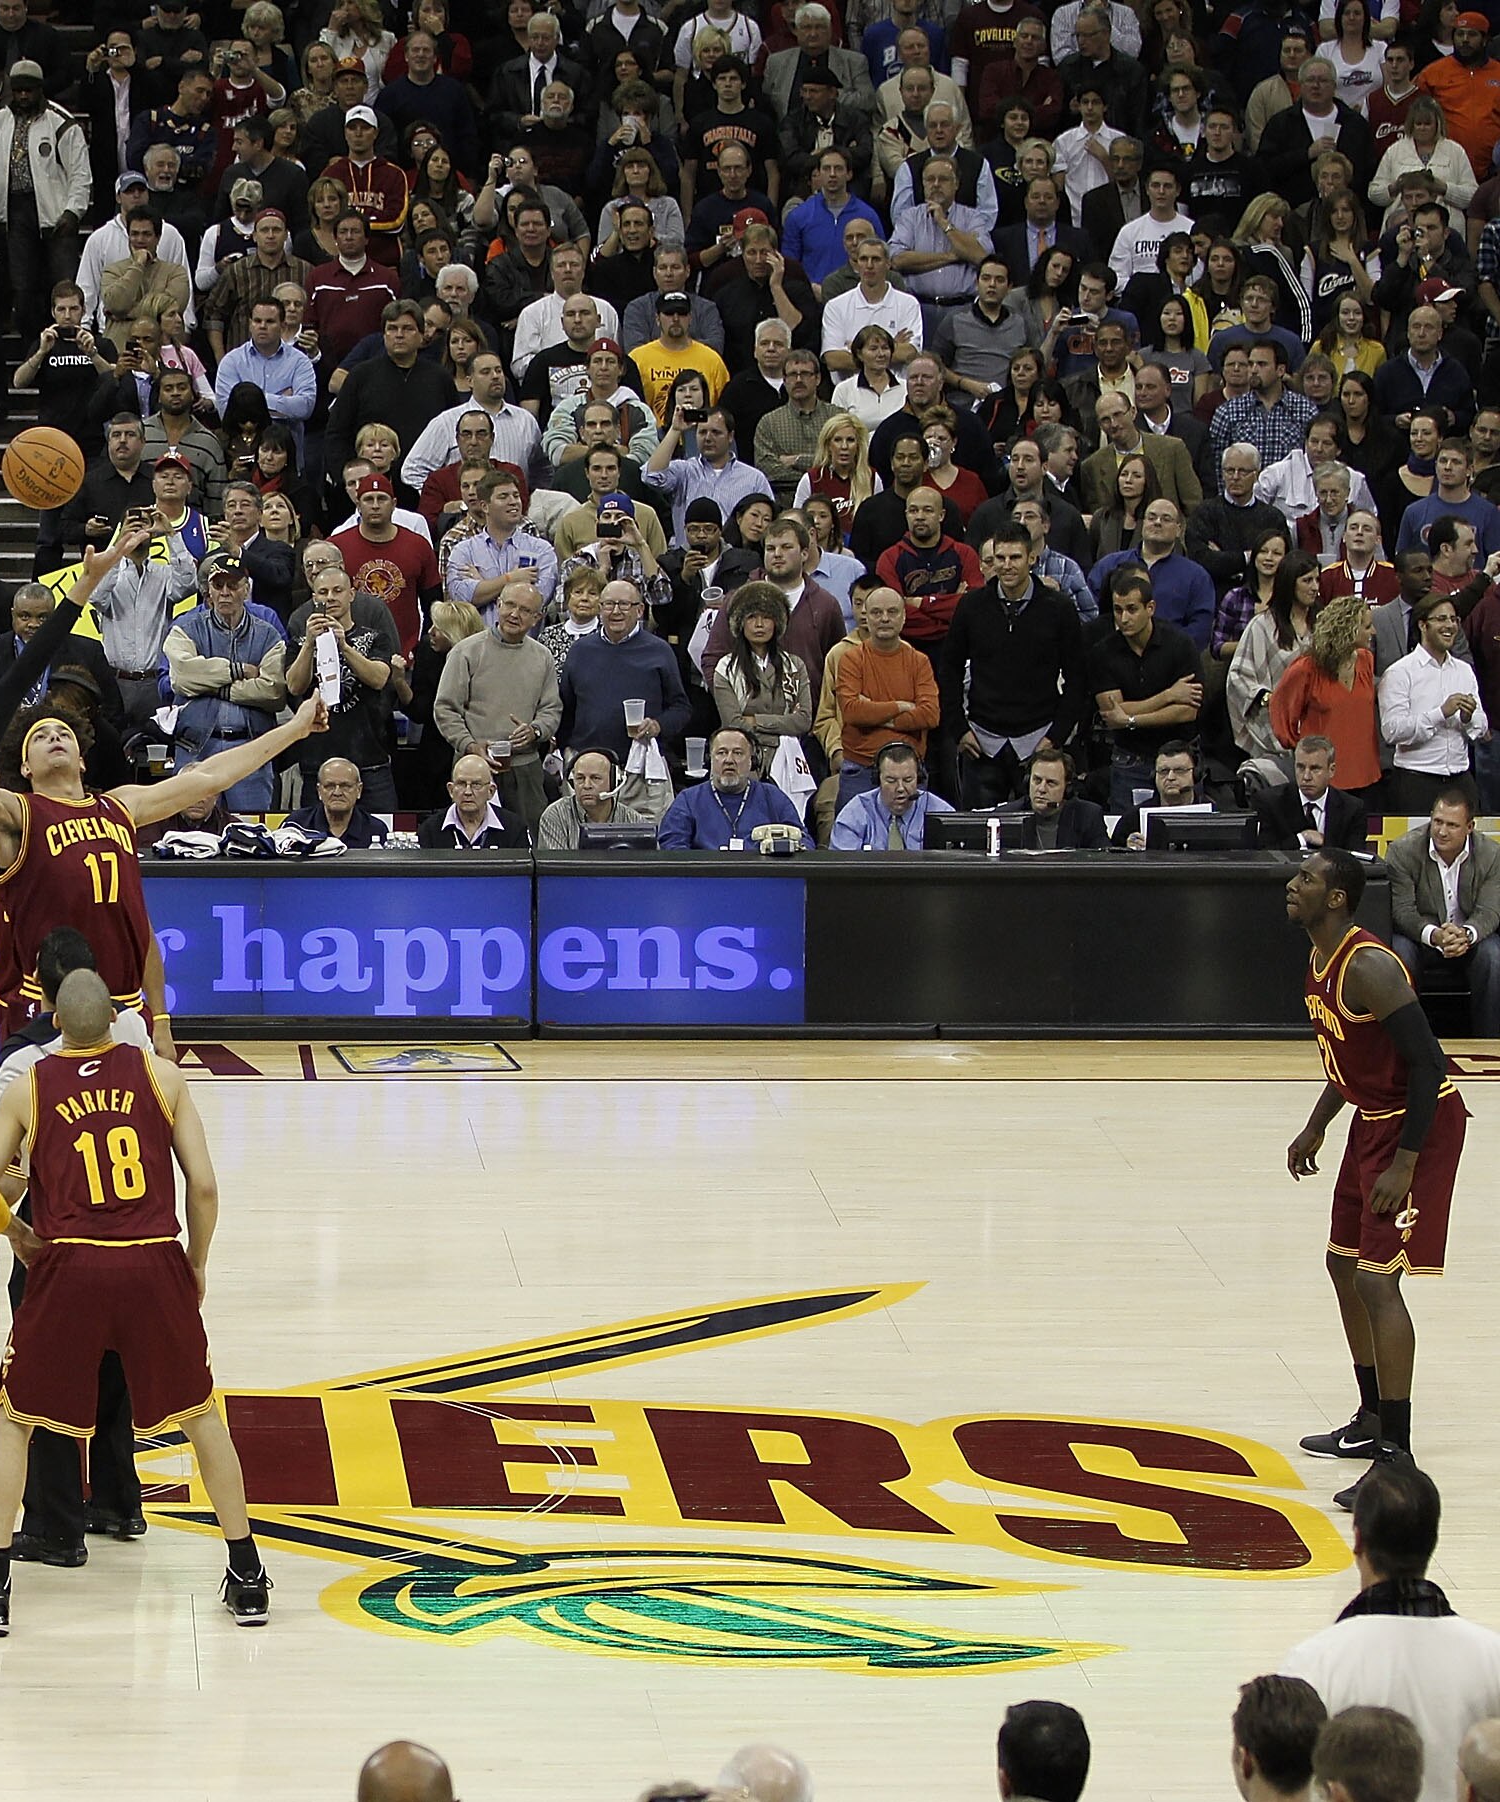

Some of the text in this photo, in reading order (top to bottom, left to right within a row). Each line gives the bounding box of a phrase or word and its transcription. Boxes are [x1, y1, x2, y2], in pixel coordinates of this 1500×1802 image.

[974, 28, 1016, 46] CAVALIER
[45, 816, 134, 857] CLEVELAND
[83, 851, 119, 904] 17
[212, 904, 793, 1017] happens.
[55, 1088, 135, 1125] PARKER
[73, 1125, 147, 1205] 18
